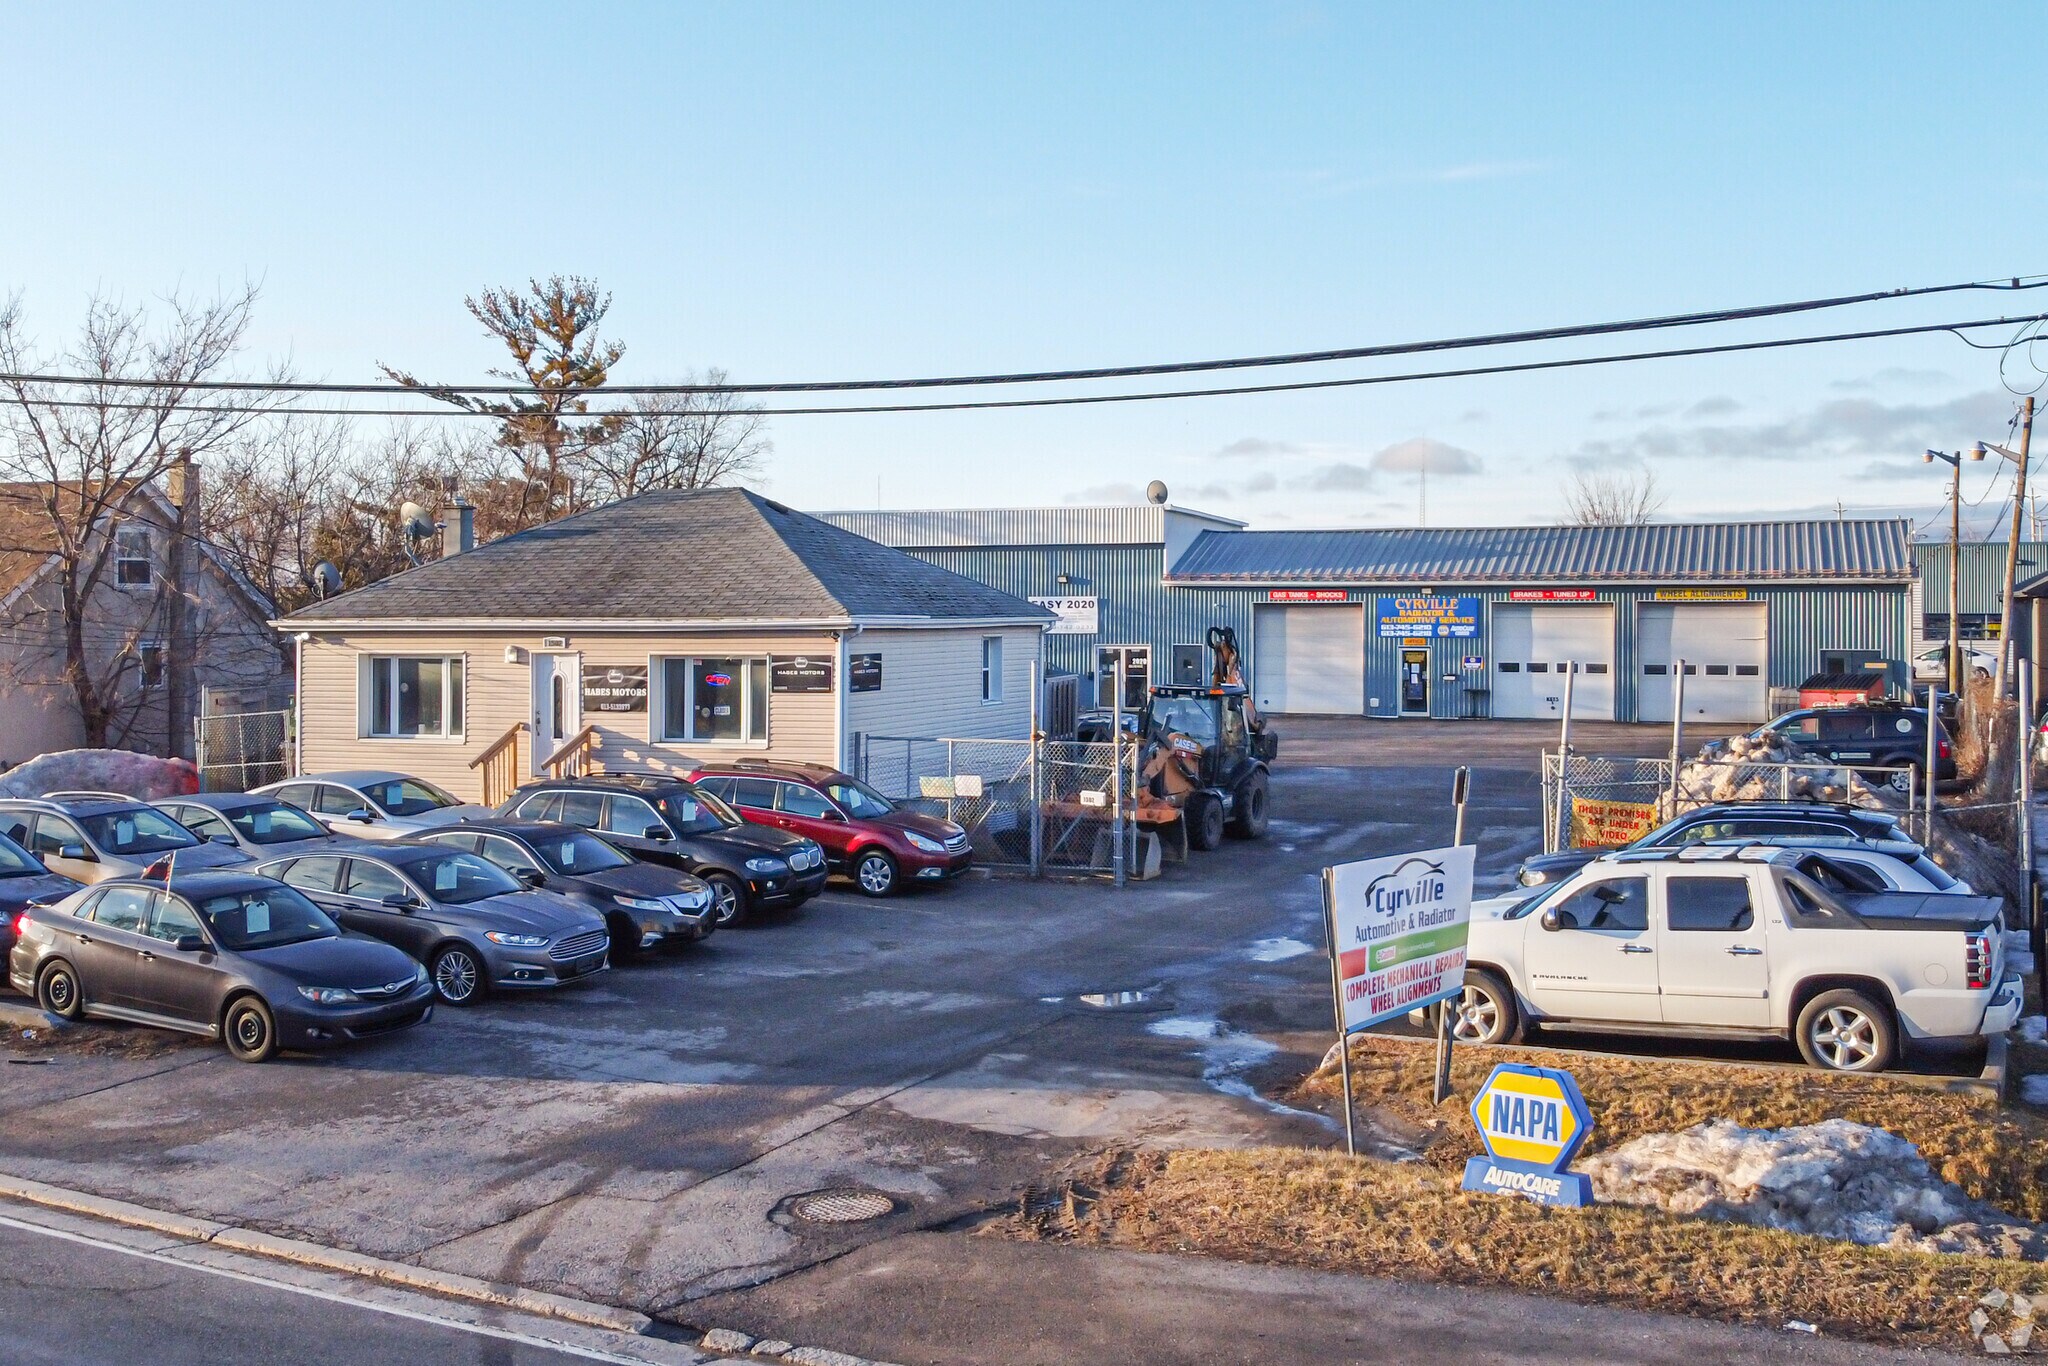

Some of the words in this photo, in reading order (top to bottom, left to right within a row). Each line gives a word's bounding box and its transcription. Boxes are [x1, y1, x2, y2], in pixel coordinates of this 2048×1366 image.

[1660, 590, 1687, 598] WHEEL
[1690, 590, 1743, 598] ALIGNMENTS
[1067, 600, 1095, 609] 2020
[1395, 598, 1459, 610] CYRVILLE
[705, 673, 731, 686] OPEN
[584, 687, 611, 697] HABES
[612, 687, 647, 697] MOTORS
[1174, 737, 1191, 750] CASE
[1578, 805, 1604, 815] THESE
[1608, 807, 1651, 820] PREMISES
[1588, 817, 1605, 827] ARE
[1609, 819, 1639, 830] UNDER
[1599, 830, 1628, 840] VIDEO
[1375, 878, 1444, 917] Cyrville
[1355, 916, 1406, 943] Automotive
[1408, 914, 1415, 930] &
[1418, 908, 1456, 926] Radiator
[1346, 974, 1385, 1002] COMPLETE
[1387, 960, 1432, 989] MECHANICAL
[1435, 951, 1464, 975] REPAIRS
[1371, 993, 1395, 1014] WHEEL
[1397, 975, 1441, 1005] ALIGNMENTS
[1492, 1094, 1558, 1142] NAPA
